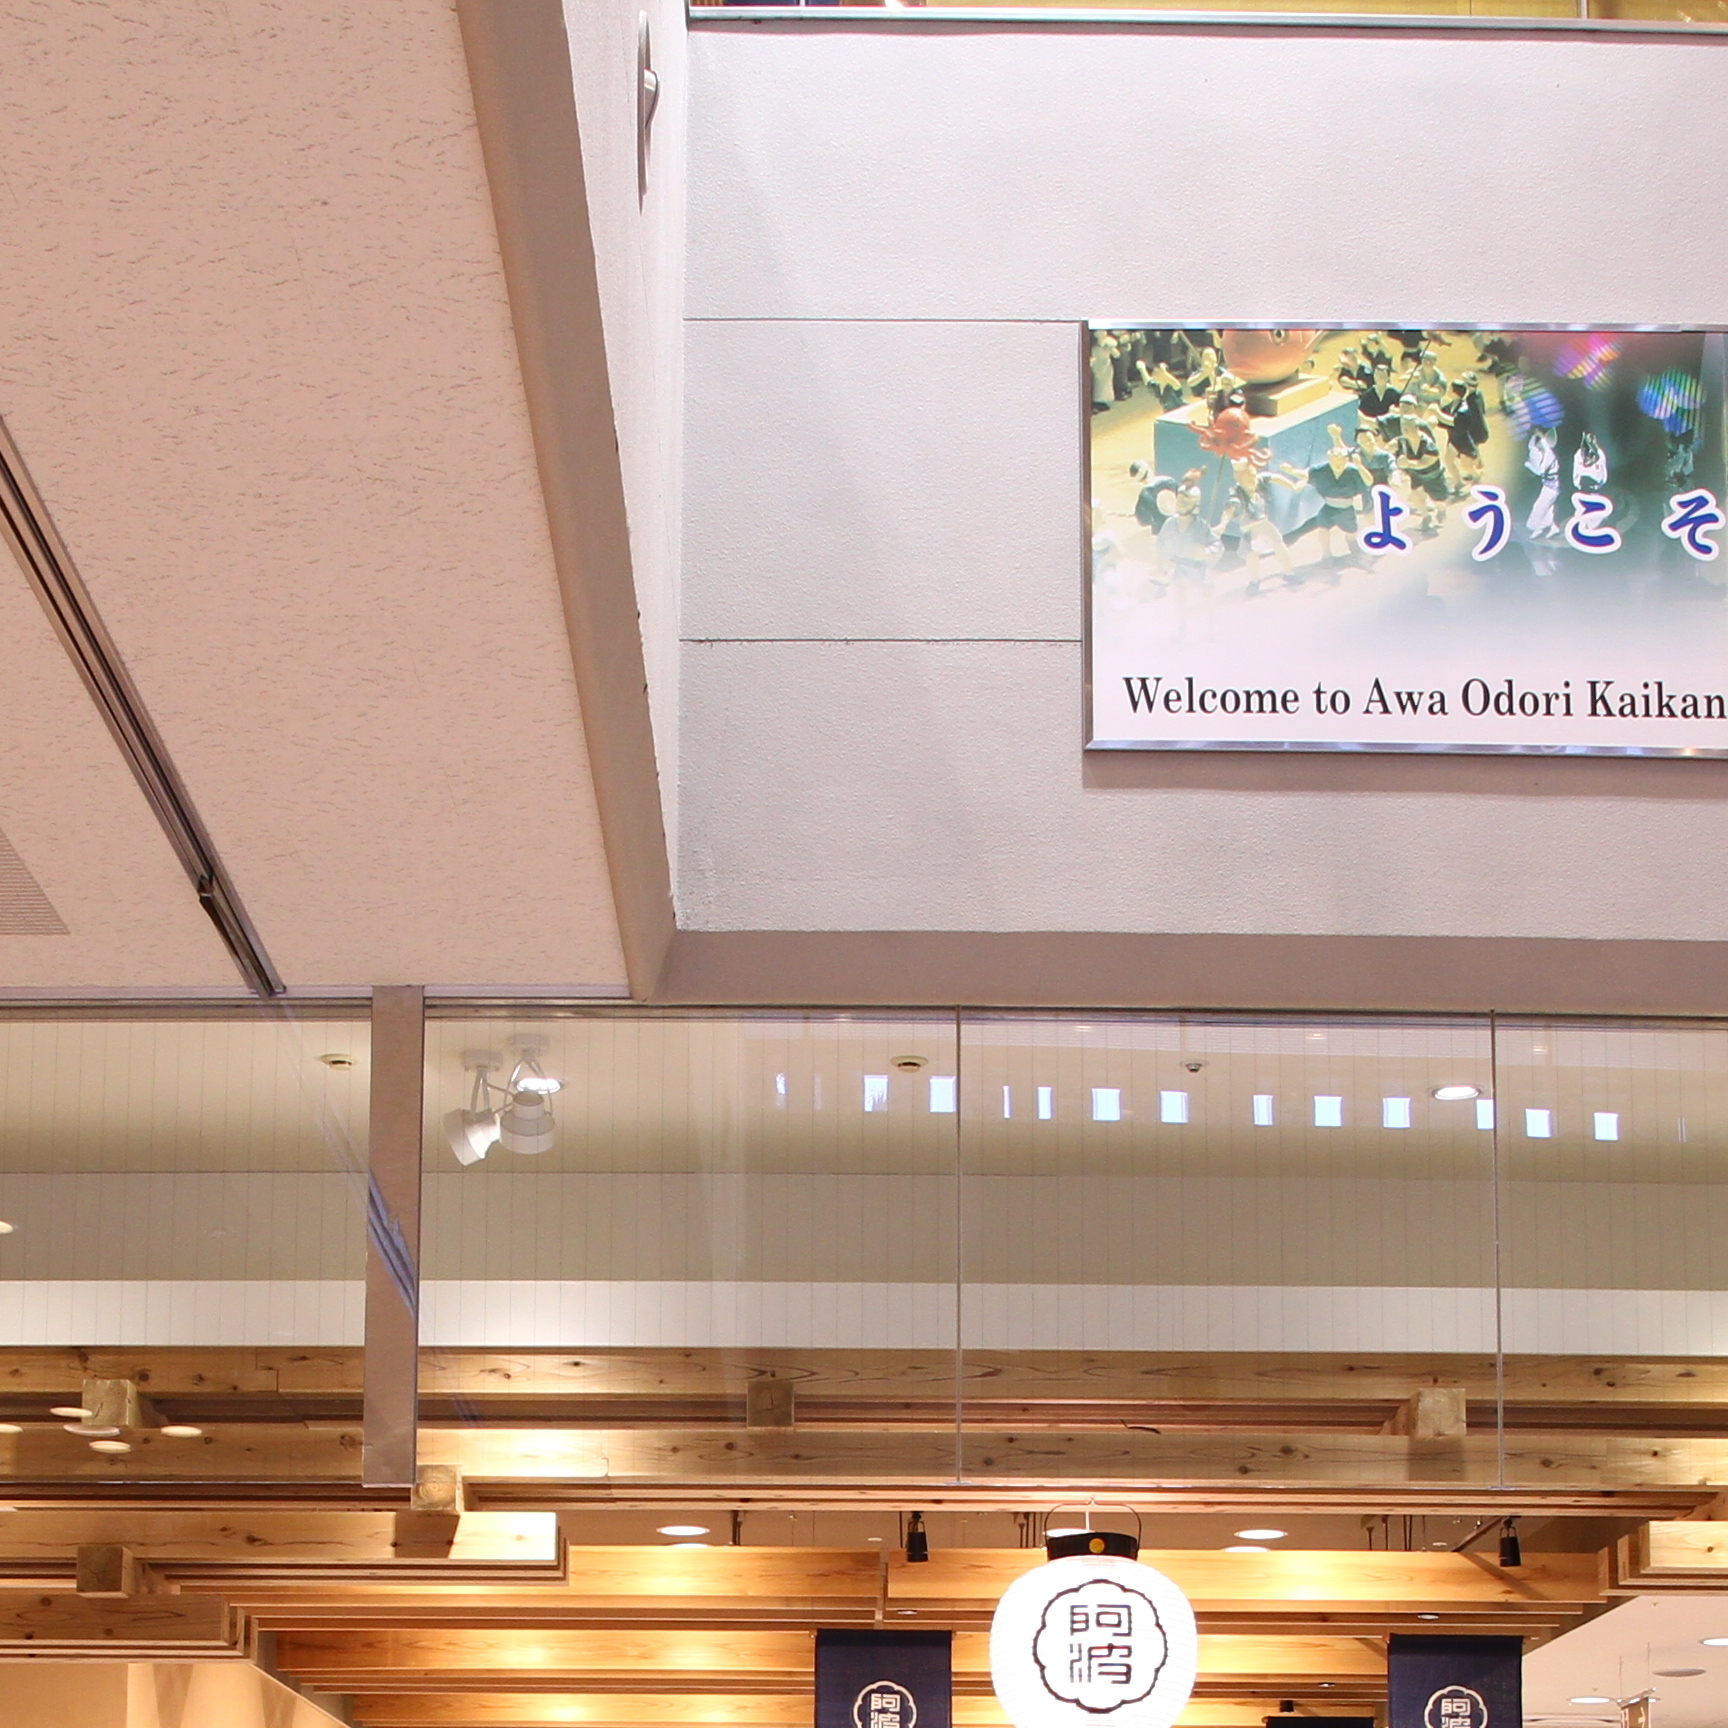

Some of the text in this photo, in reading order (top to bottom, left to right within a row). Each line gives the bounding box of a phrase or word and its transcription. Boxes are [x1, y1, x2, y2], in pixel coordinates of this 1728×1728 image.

[1122, 677, 1728, 722] Welcome to Awa Odori Kaikan
[1069, 1604, 1132, 1684] 阿波
